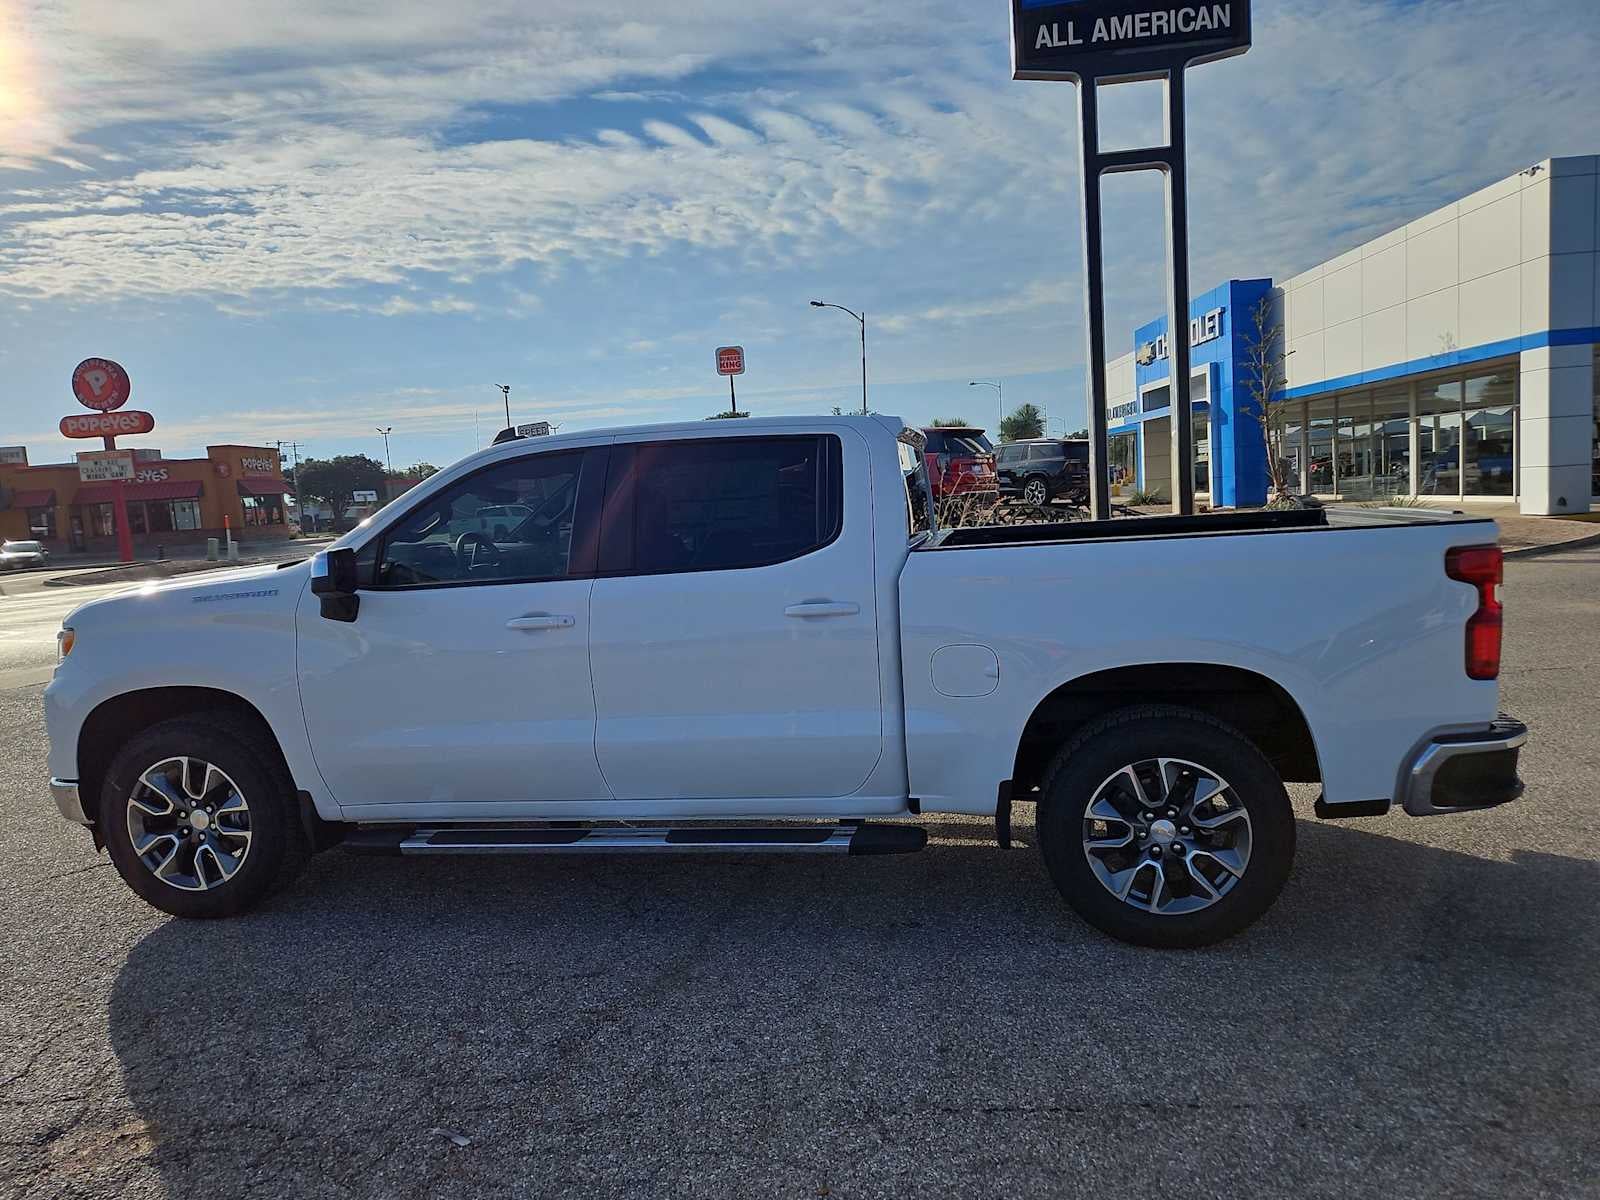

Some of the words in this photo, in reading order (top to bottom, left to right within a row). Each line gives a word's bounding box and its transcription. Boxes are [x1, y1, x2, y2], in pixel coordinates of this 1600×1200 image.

[1035, 21, 1083, 49] ALL
[1091, 4, 1231, 43] AMERICAN
[1156, 306, 1226, 361] CHOLET
